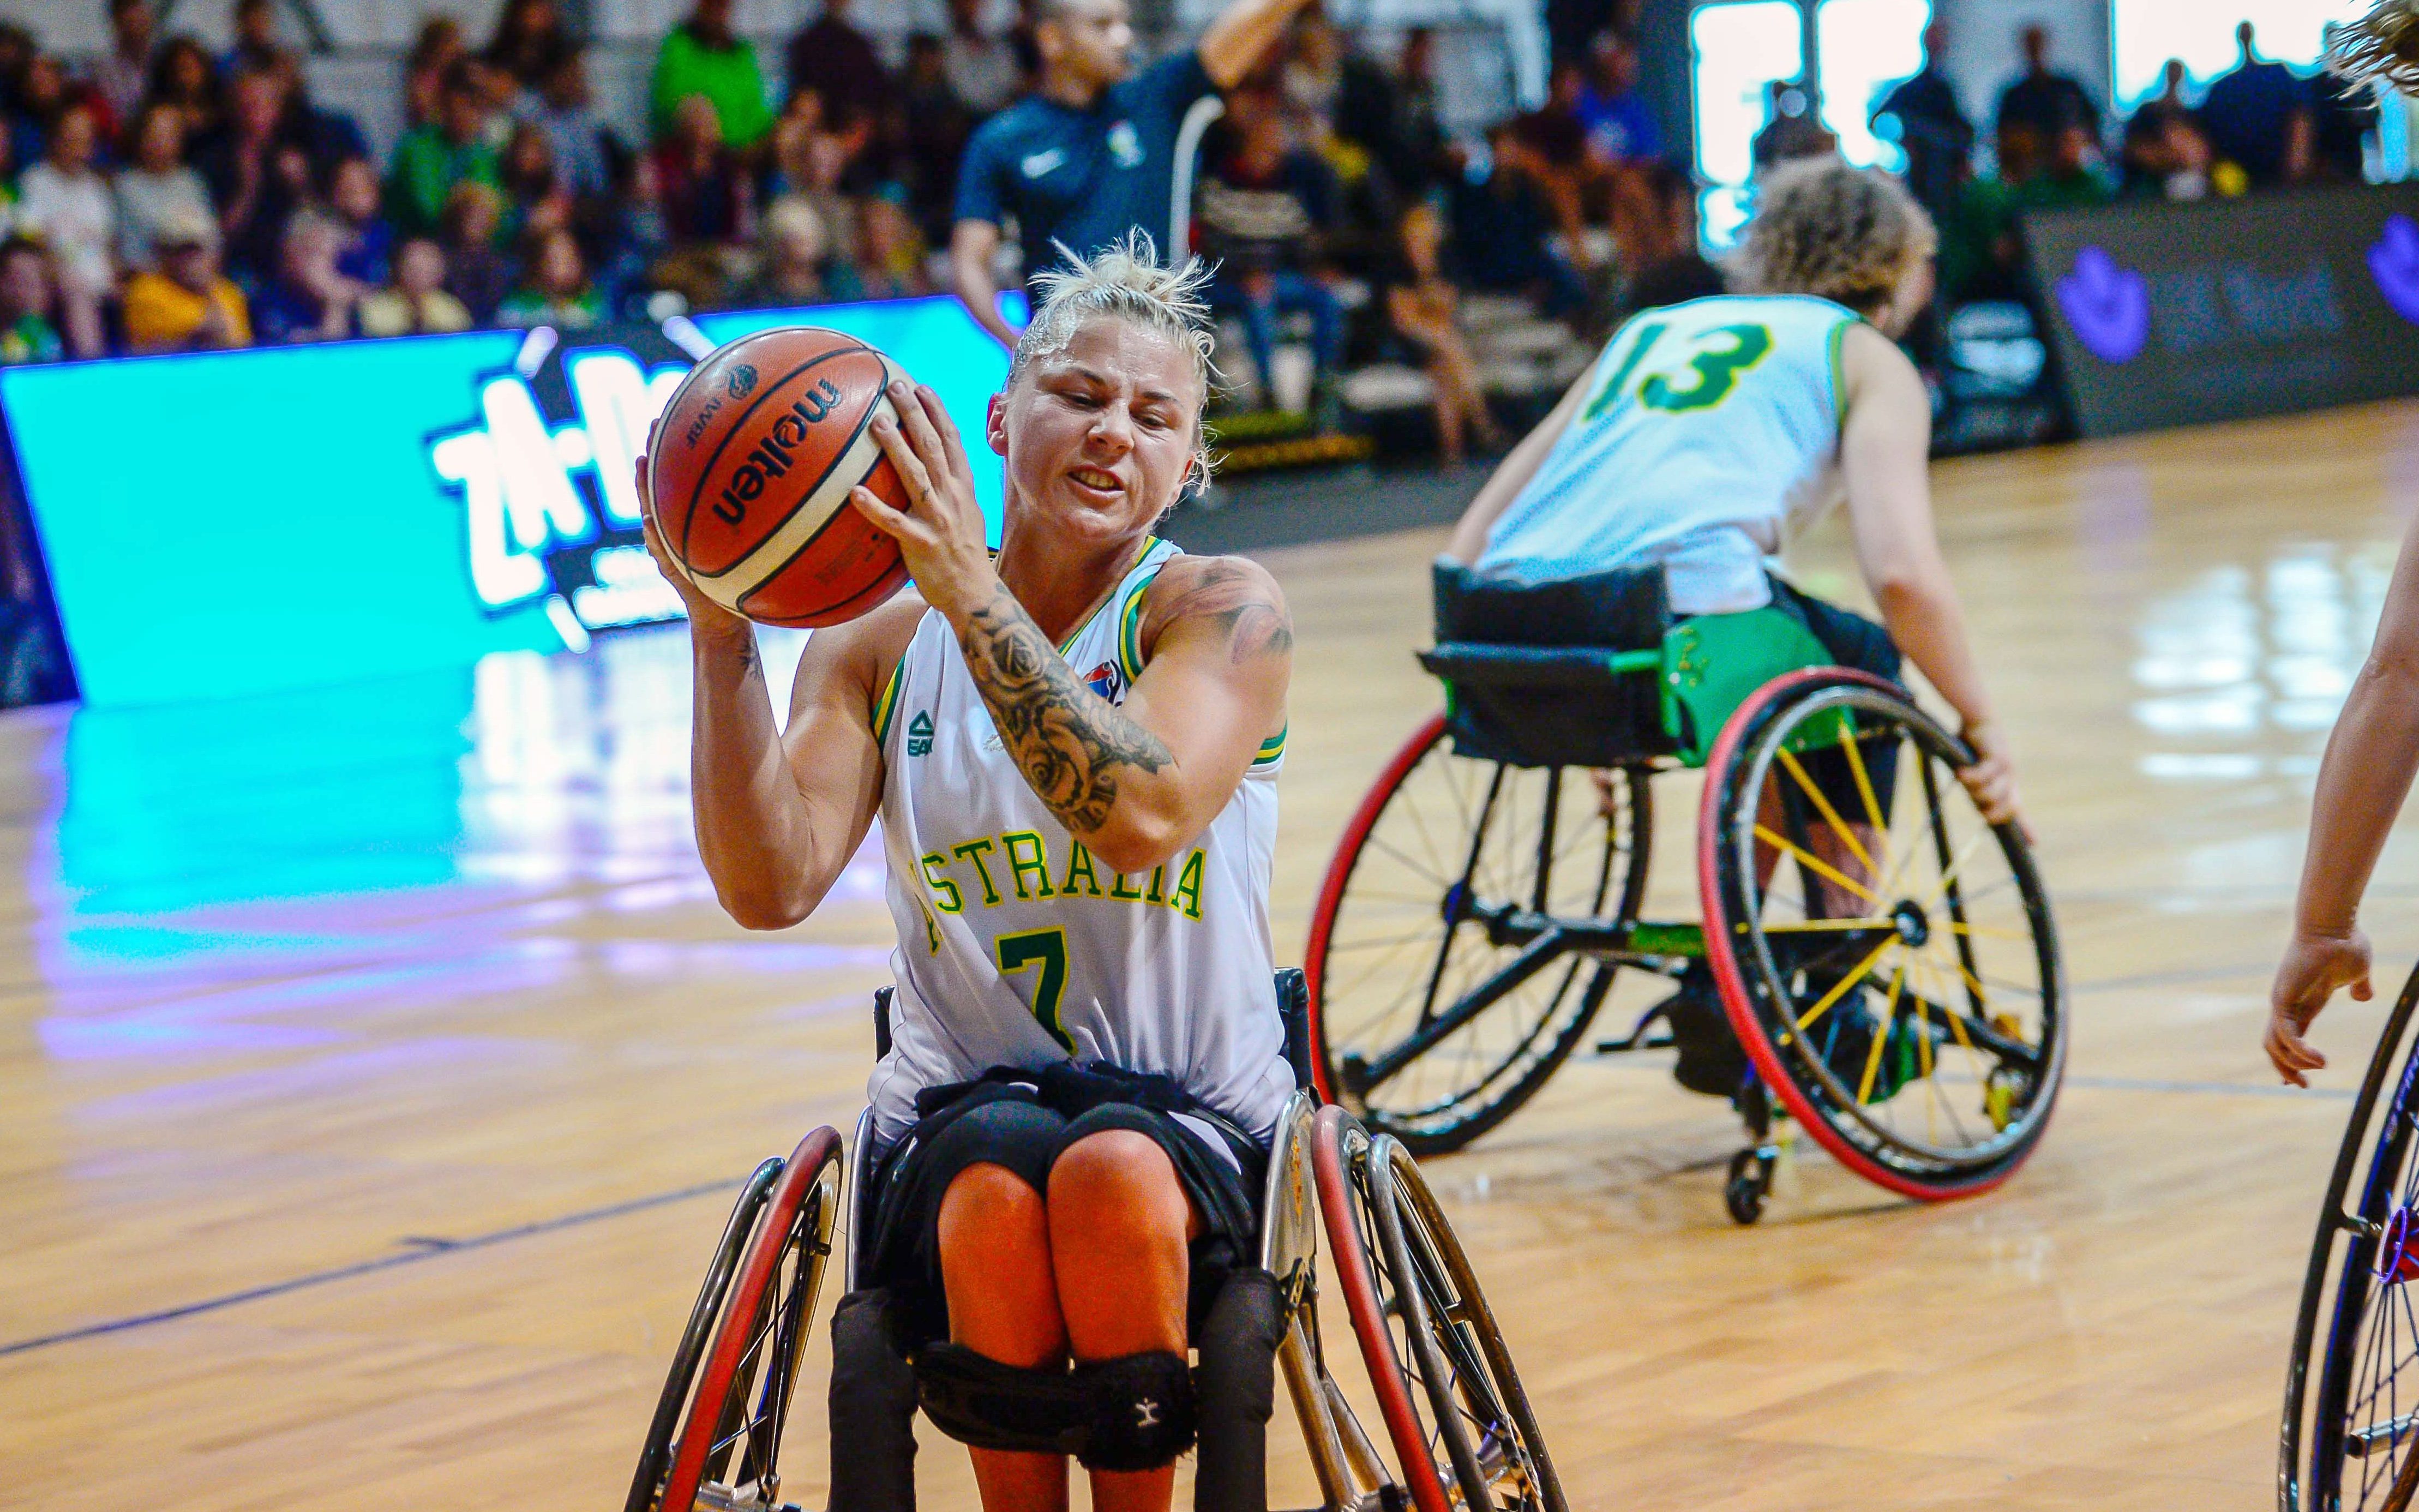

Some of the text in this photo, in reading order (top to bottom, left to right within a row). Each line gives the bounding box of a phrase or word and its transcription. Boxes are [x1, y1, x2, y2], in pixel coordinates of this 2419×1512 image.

[1582, 323, 1776, 425] 13
[713, 378, 843, 525] molten
[908, 829, 1207, 957] STRALIA
[993, 923, 1078, 1058] 7
